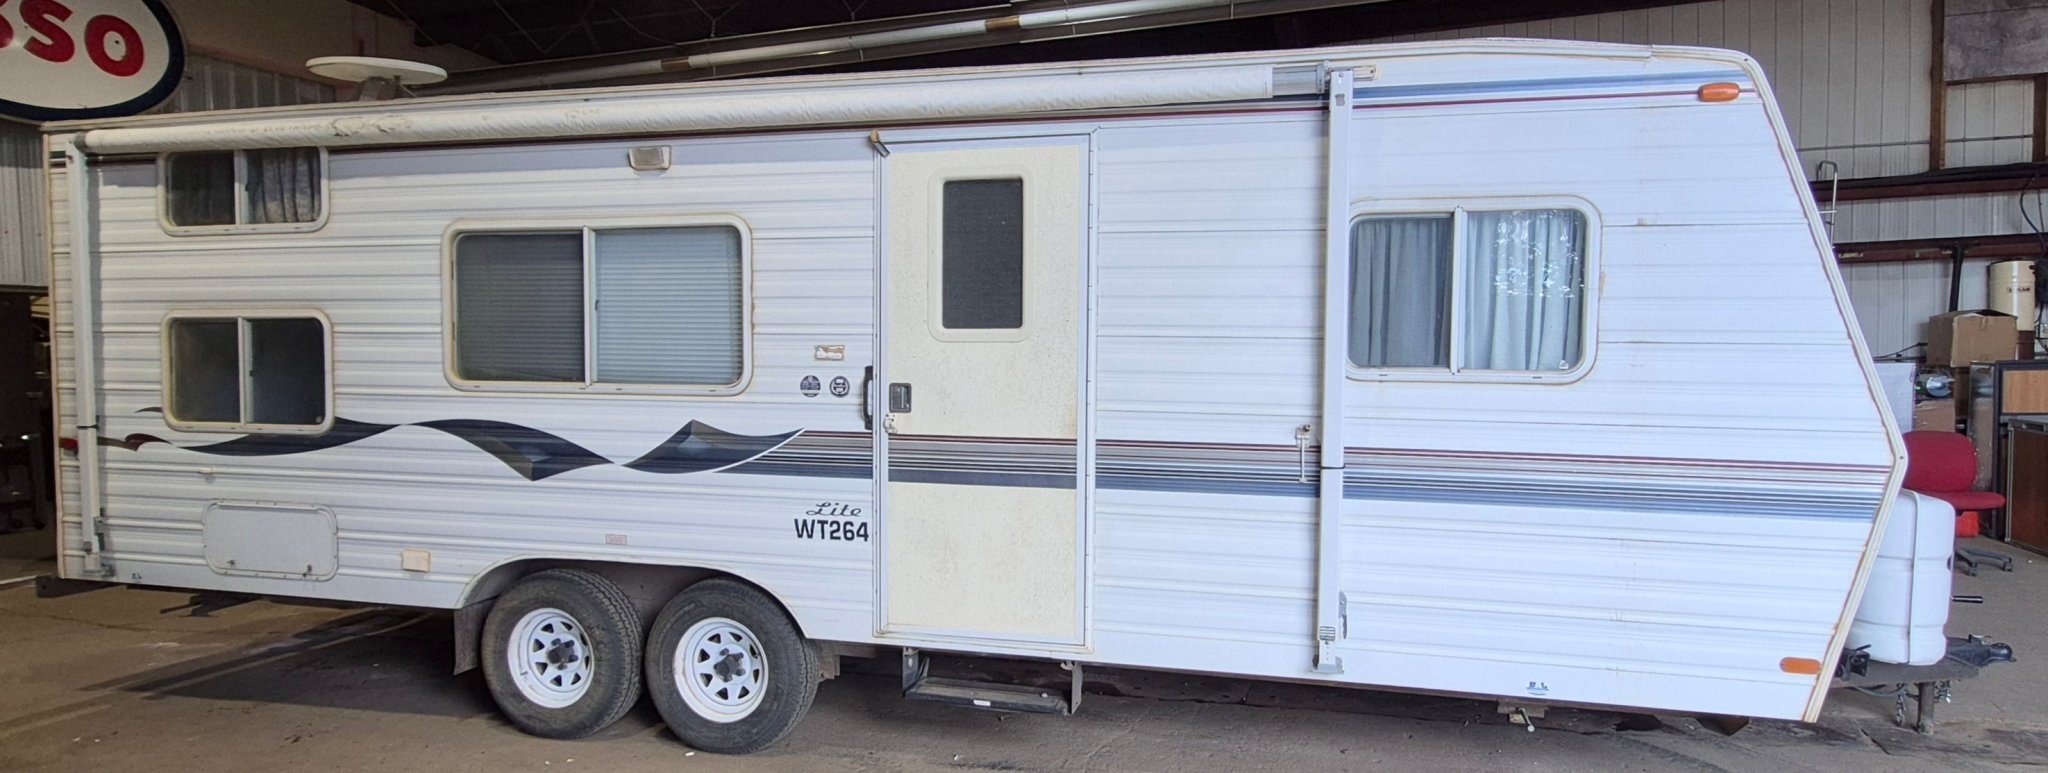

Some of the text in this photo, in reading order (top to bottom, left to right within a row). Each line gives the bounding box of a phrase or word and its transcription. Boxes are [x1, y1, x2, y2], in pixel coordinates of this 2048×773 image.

[0, 0, 144, 77] SO
[806, 502, 862, 517] Lite
[794, 518, 869, 542] WT264
